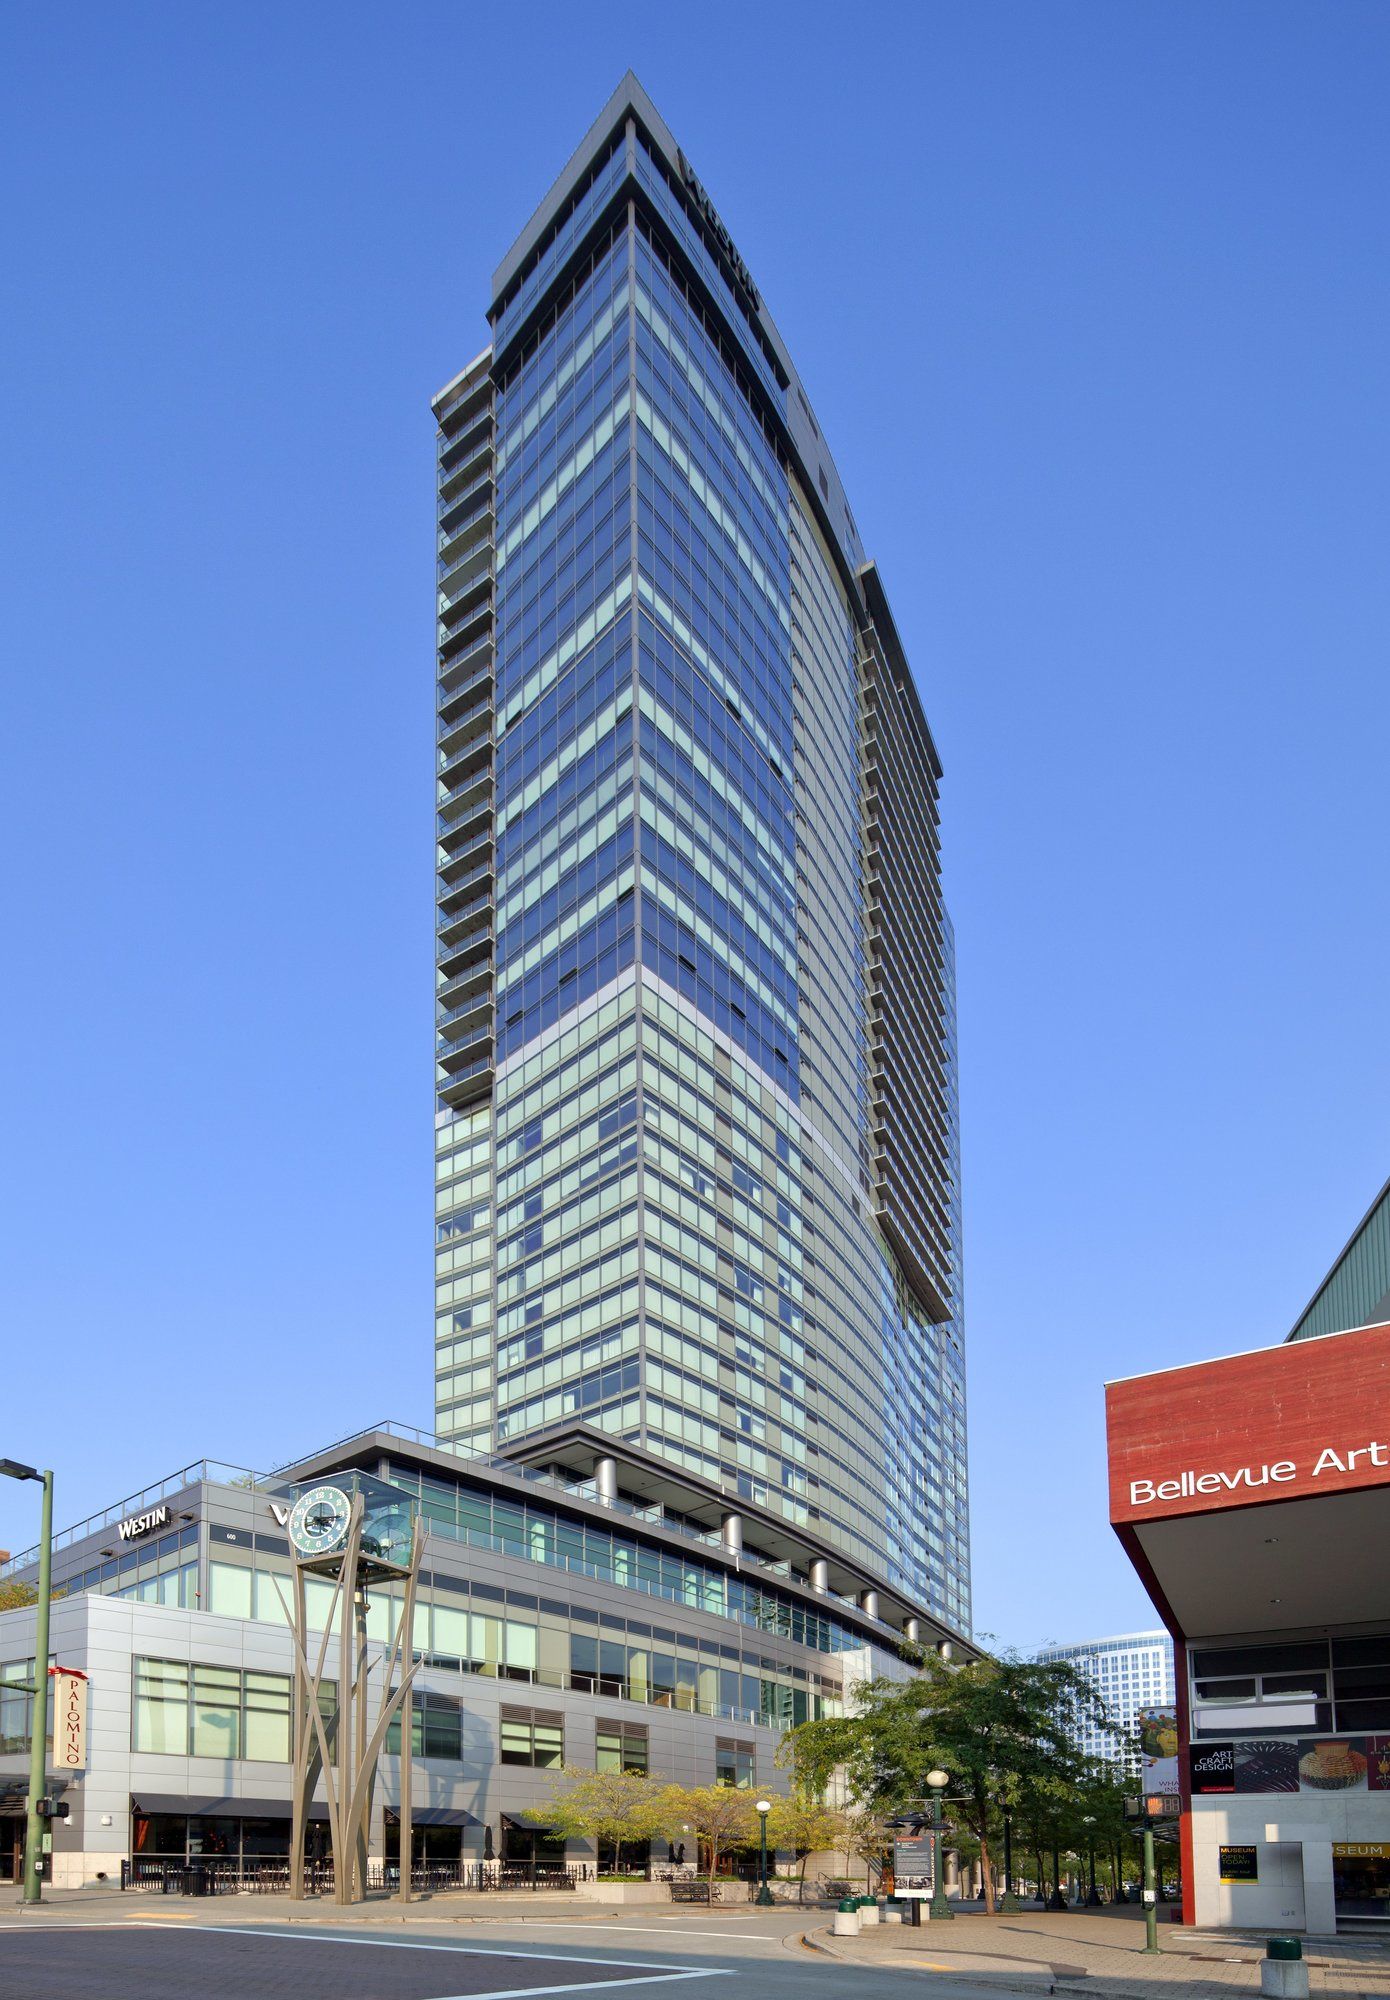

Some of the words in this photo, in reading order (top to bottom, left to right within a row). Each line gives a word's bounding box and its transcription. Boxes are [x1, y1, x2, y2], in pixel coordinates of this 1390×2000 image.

[1130, 1460, 1296, 1505] Bellevue
[1312, 1441, 1389, 1477] Art
[316, 1491, 325, 1499] 12
[117, 1505, 167, 1541] WESTIN
[226, 1532, 236, 1541] 600
[66, 1680, 80, 1764] PALOMINO
[1199, 1757, 1233, 1765] CRAFT
[1194, 1763, 1233, 1771] DESIGN
[1333, 1846, 1383, 1855] SEUM
